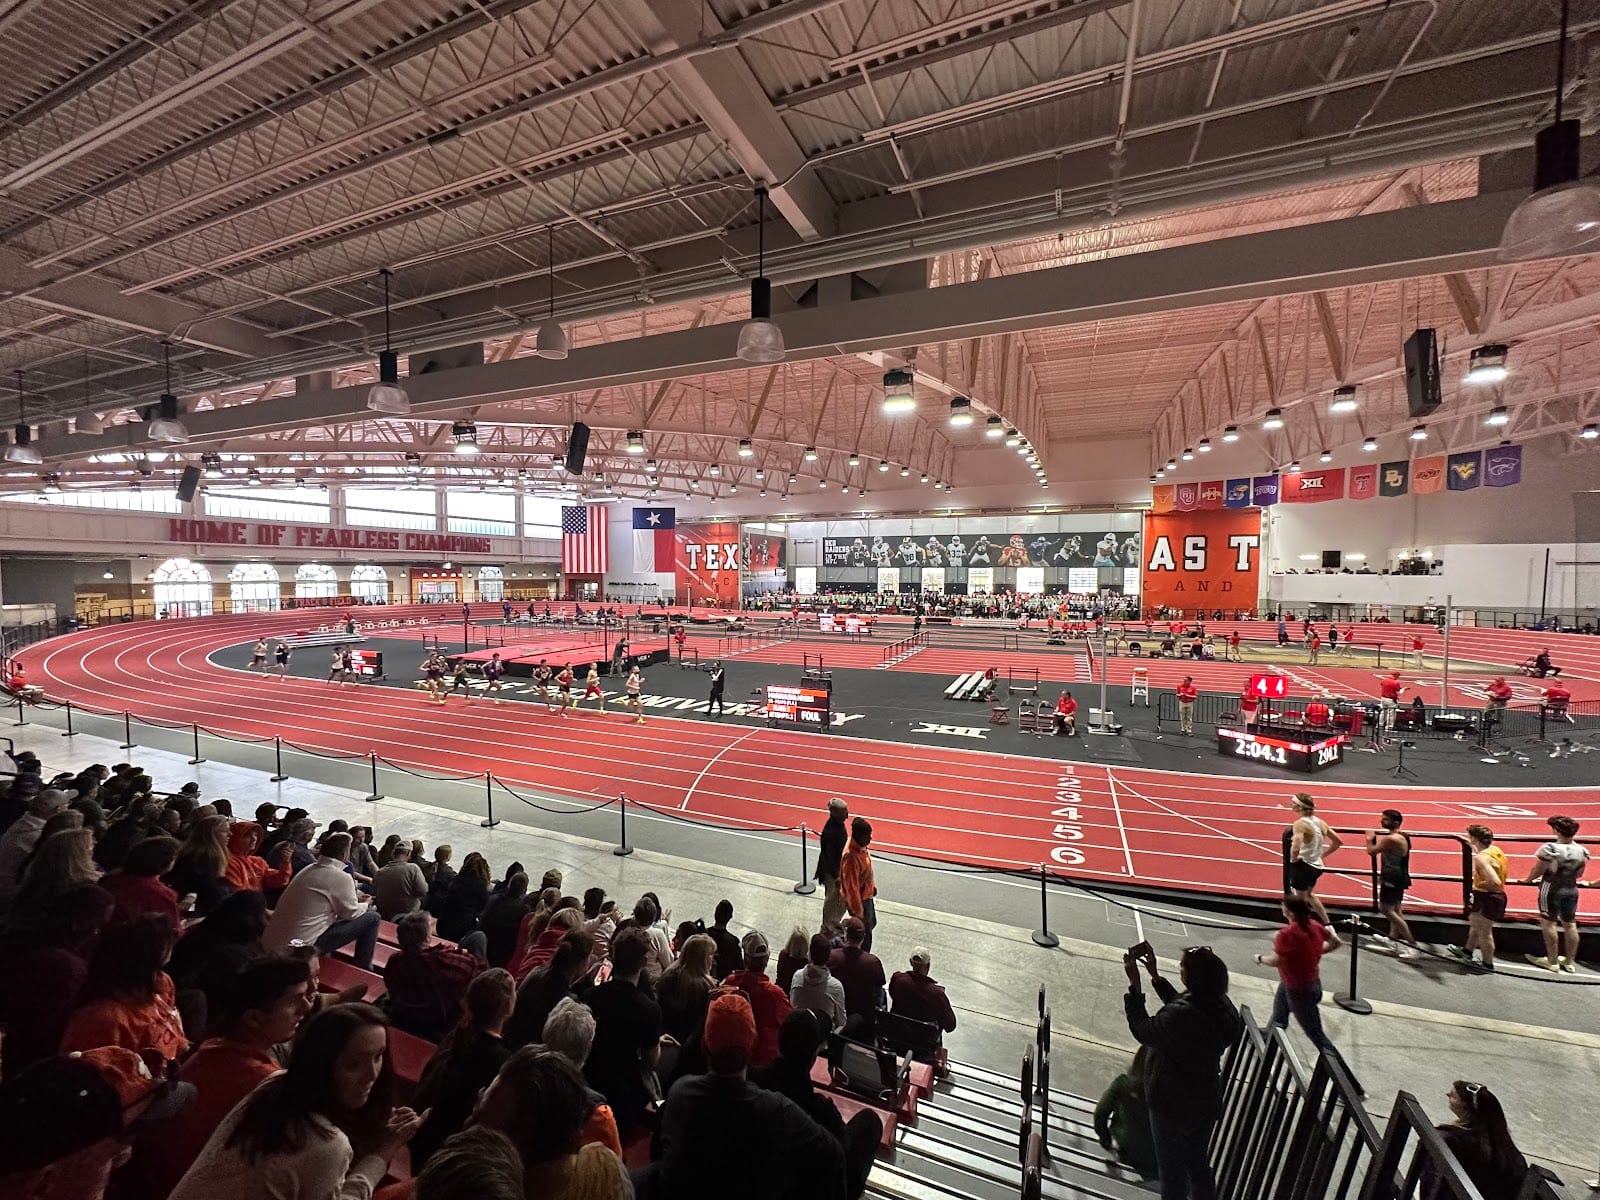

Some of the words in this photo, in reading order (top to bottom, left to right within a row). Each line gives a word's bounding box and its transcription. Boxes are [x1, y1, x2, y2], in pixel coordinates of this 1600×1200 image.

[169, 519, 247, 544] HOME
[257, 524, 286, 545] OF
[296, 527, 399, 550] FEARLESS
[405, 533, 491, 553] CHAMPIONS
[685, 543, 738, 571] TEX
[1148, 535, 1207, 571] AS
[1228, 535, 1260, 571] T
[1174, 580, 1233, 592] AND
[1257, 678, 1268, 694] 4
[1276, 678, 1284, 694] 4
[801, 710, 821, 722] FOUL
[1235, 738, 1288, 764] 2:04.1
[1057, 777, 1082, 788] 2
[1055, 790, 1082, 803] 3
[1051, 807, 1083, 821] 4
[1052, 824, 1084, 840] 5
[1050, 846, 1086, 865] 6
